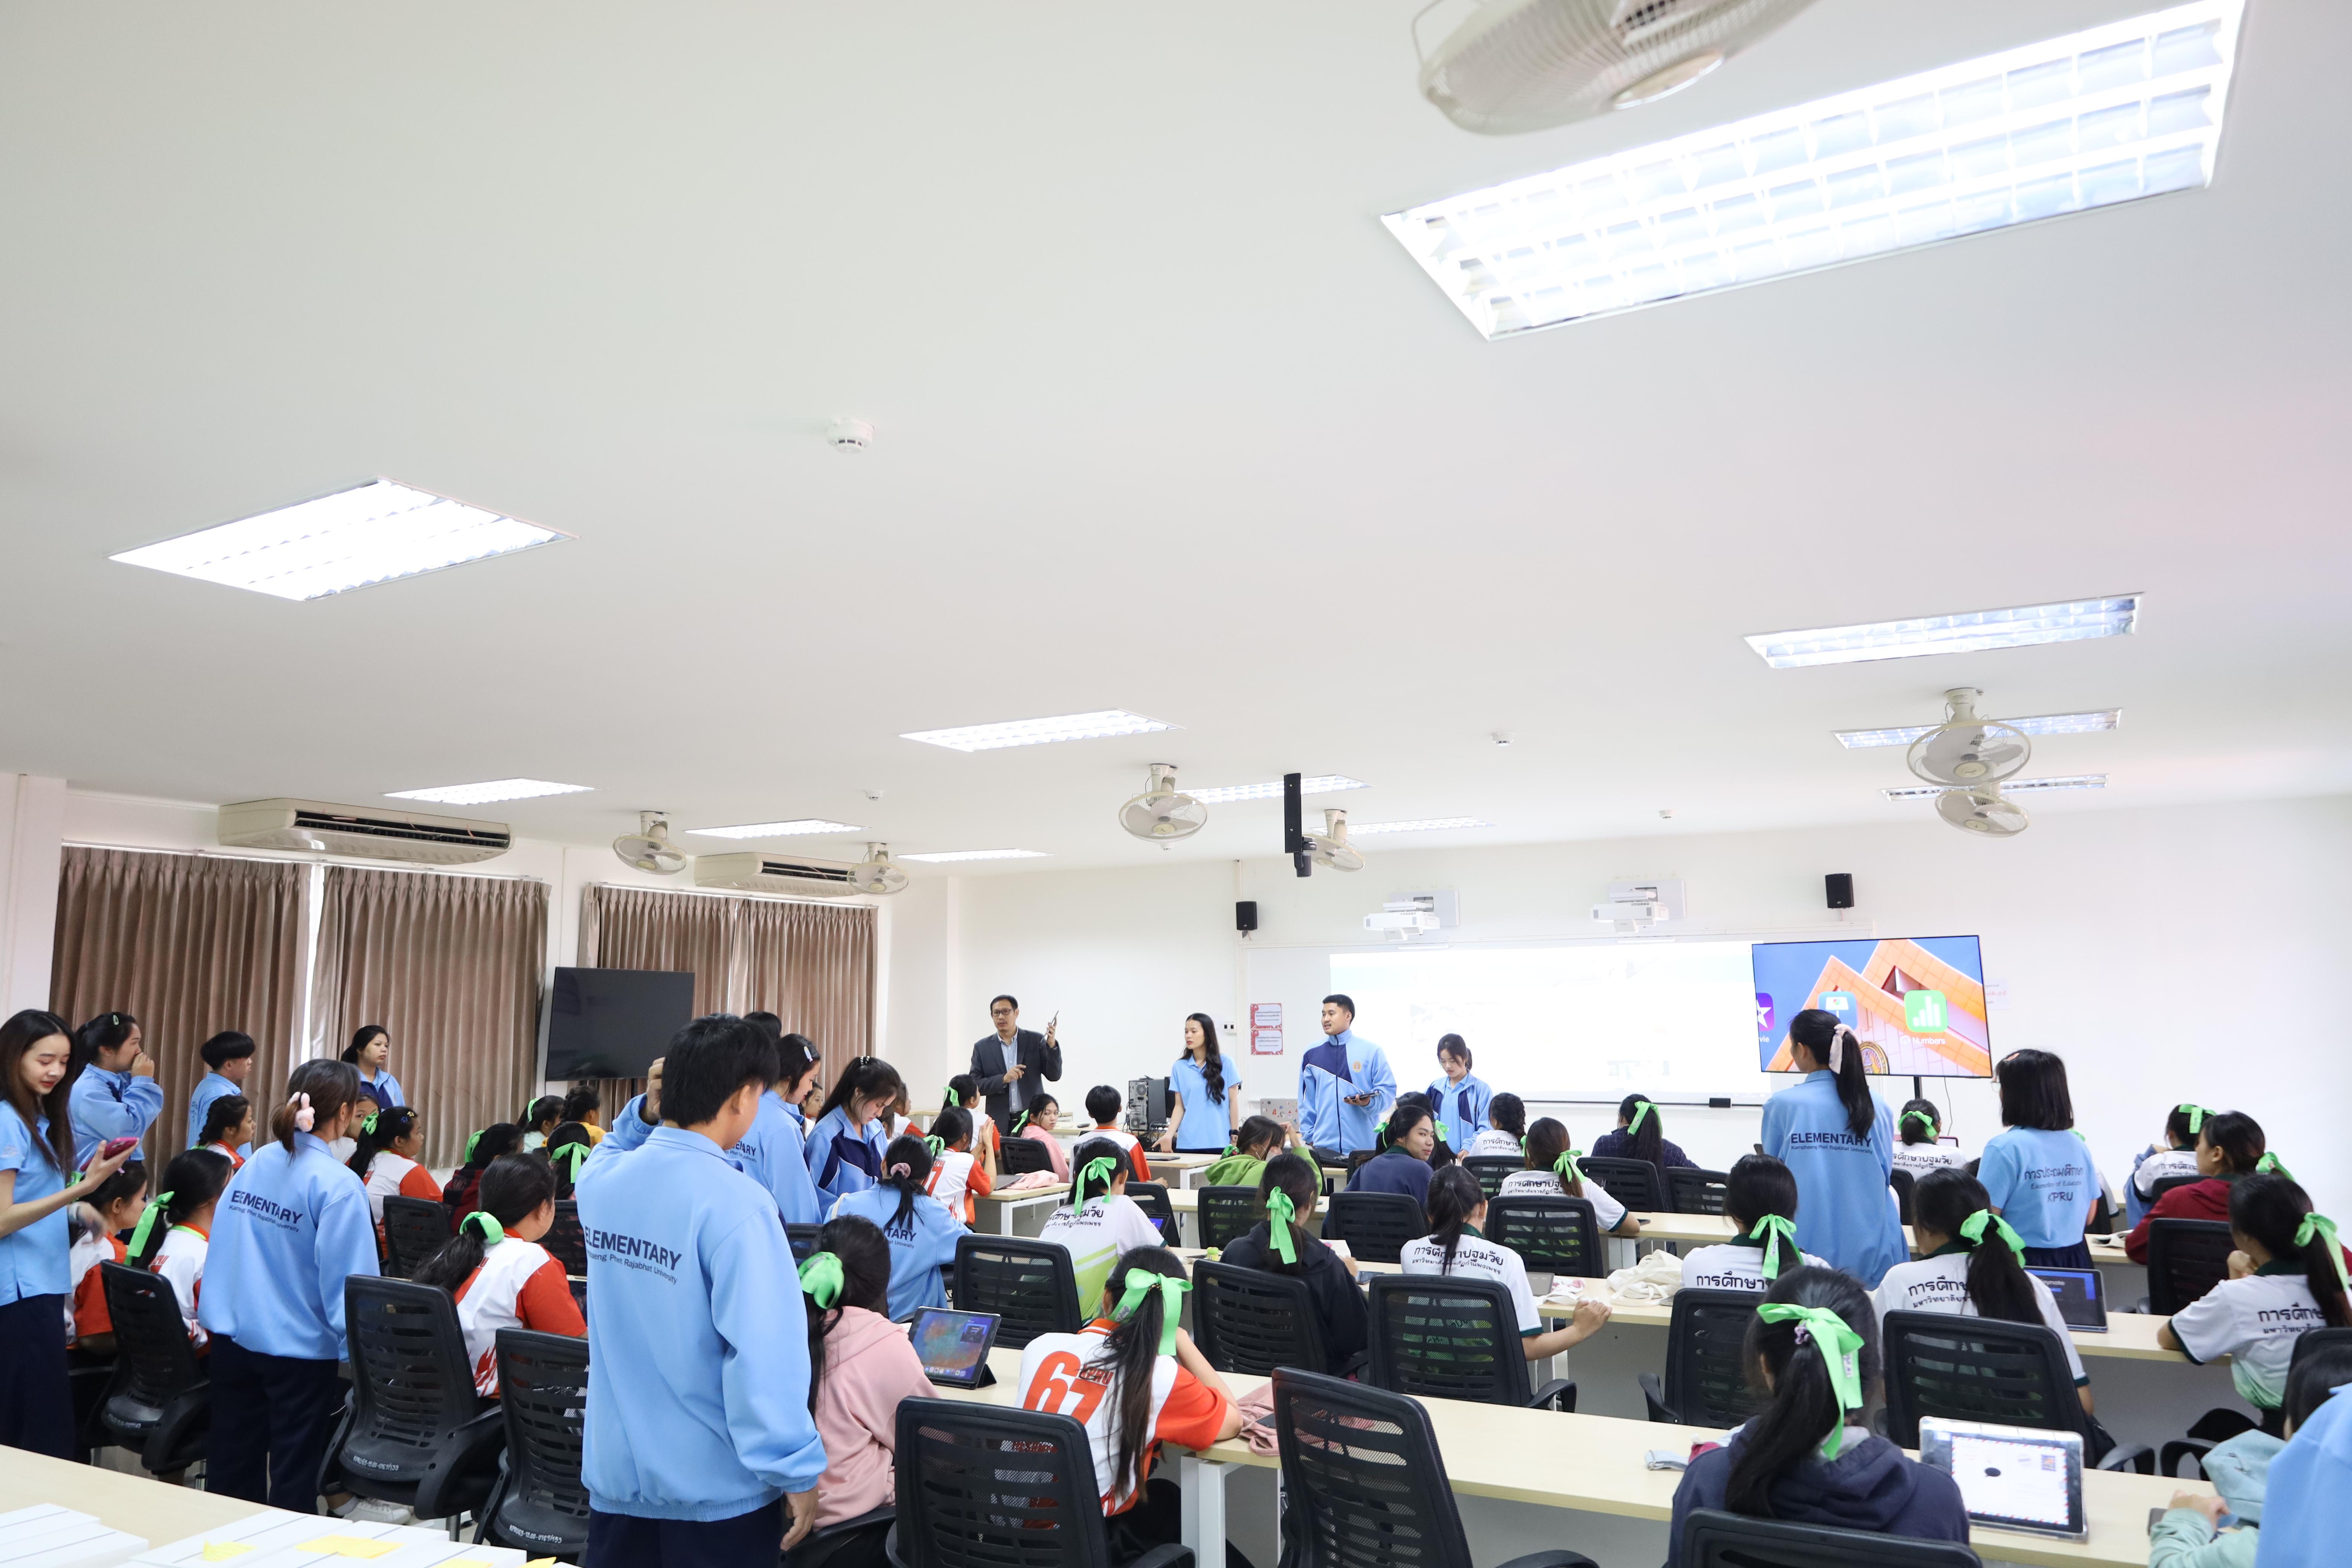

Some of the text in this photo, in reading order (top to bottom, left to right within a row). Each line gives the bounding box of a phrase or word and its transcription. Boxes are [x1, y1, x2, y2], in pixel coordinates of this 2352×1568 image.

[2047, 1191, 2073, 1203] KPRU
[585, 1225, 682, 1271] ELEMENTARY
[894, 1240, 915, 1249] University
[609, 1253, 623, 1265] Phet
[624, 1259, 652, 1272] Rajabhat
[654, 1266, 678, 1285] University
